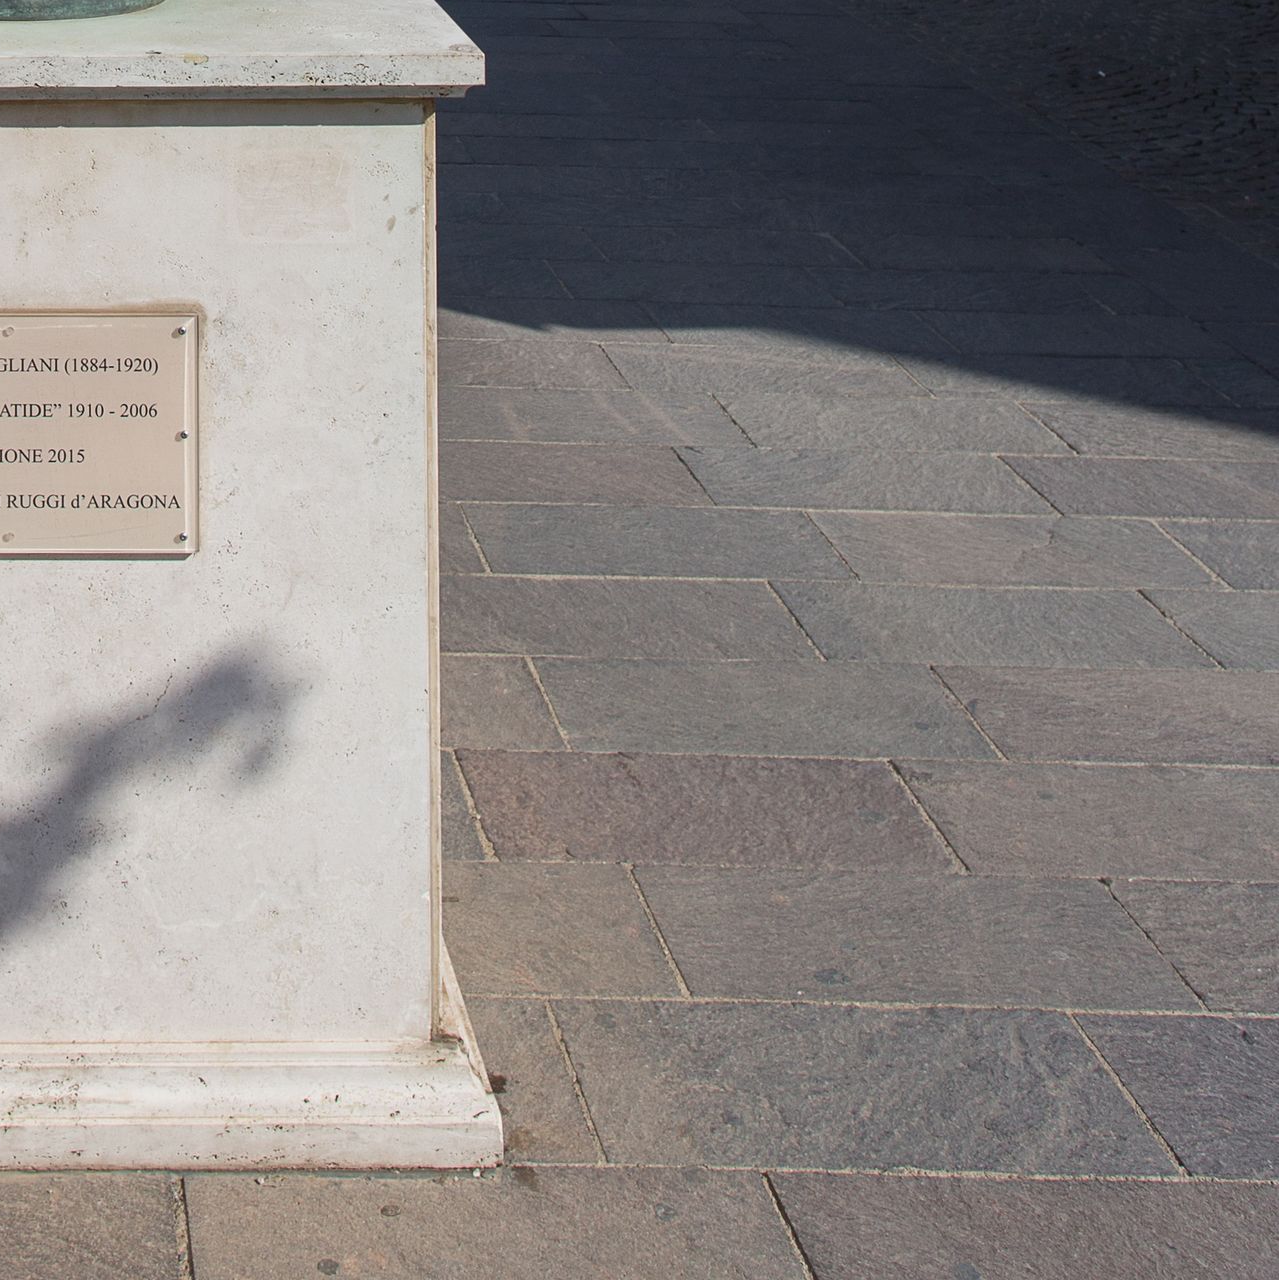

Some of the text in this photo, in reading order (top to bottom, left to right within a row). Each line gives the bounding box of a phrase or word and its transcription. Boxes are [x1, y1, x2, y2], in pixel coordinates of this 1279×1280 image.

[64, 357, 159, 375] (1884-1920)
[68, 403, 105, 418] 1910
[120, 403, 158, 418] 2006
[48, 448, 85, 464] 2015
[6, 494, 66, 509] RUGGI
[70, 494, 181, 509] d’ARAGONA
